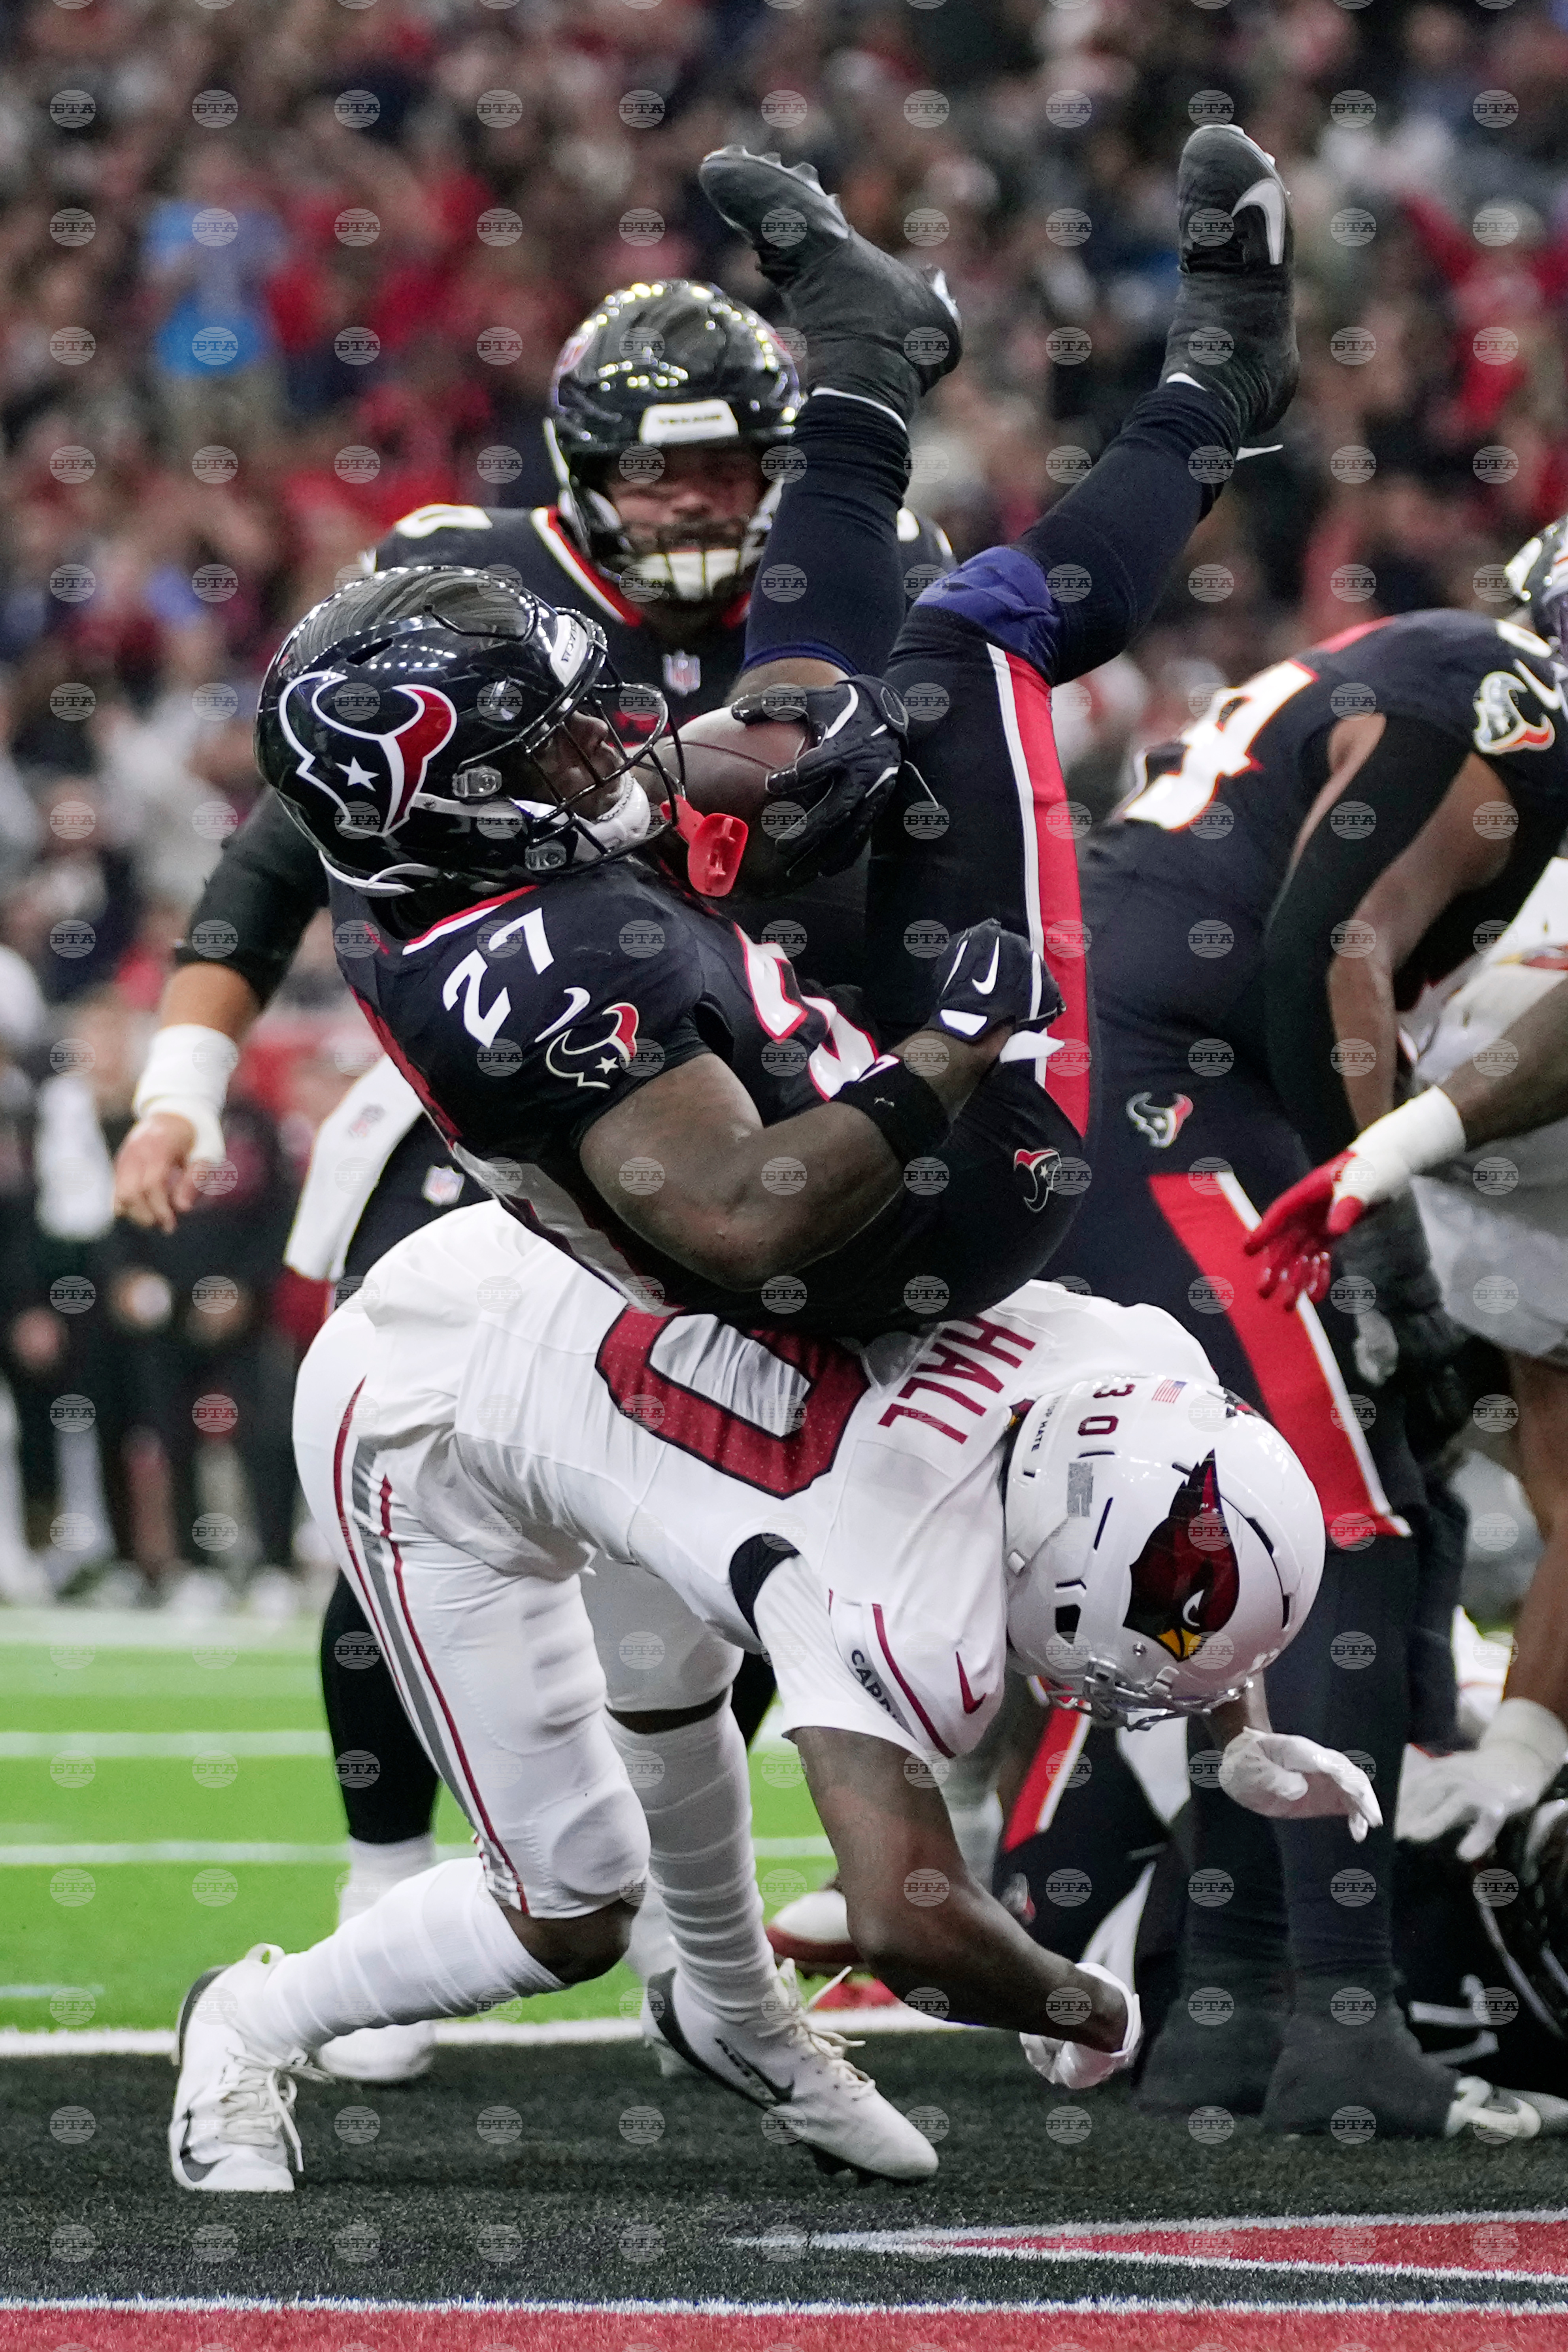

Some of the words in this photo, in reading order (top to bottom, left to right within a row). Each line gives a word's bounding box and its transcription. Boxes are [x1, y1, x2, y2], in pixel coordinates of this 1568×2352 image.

[442, 907, 554, 1049] 27
[877, 1314, 1036, 1445] HALL
[1077, 1384, 1136, 1436] 30
[1031, 1420, 1048, 1452] HATE
